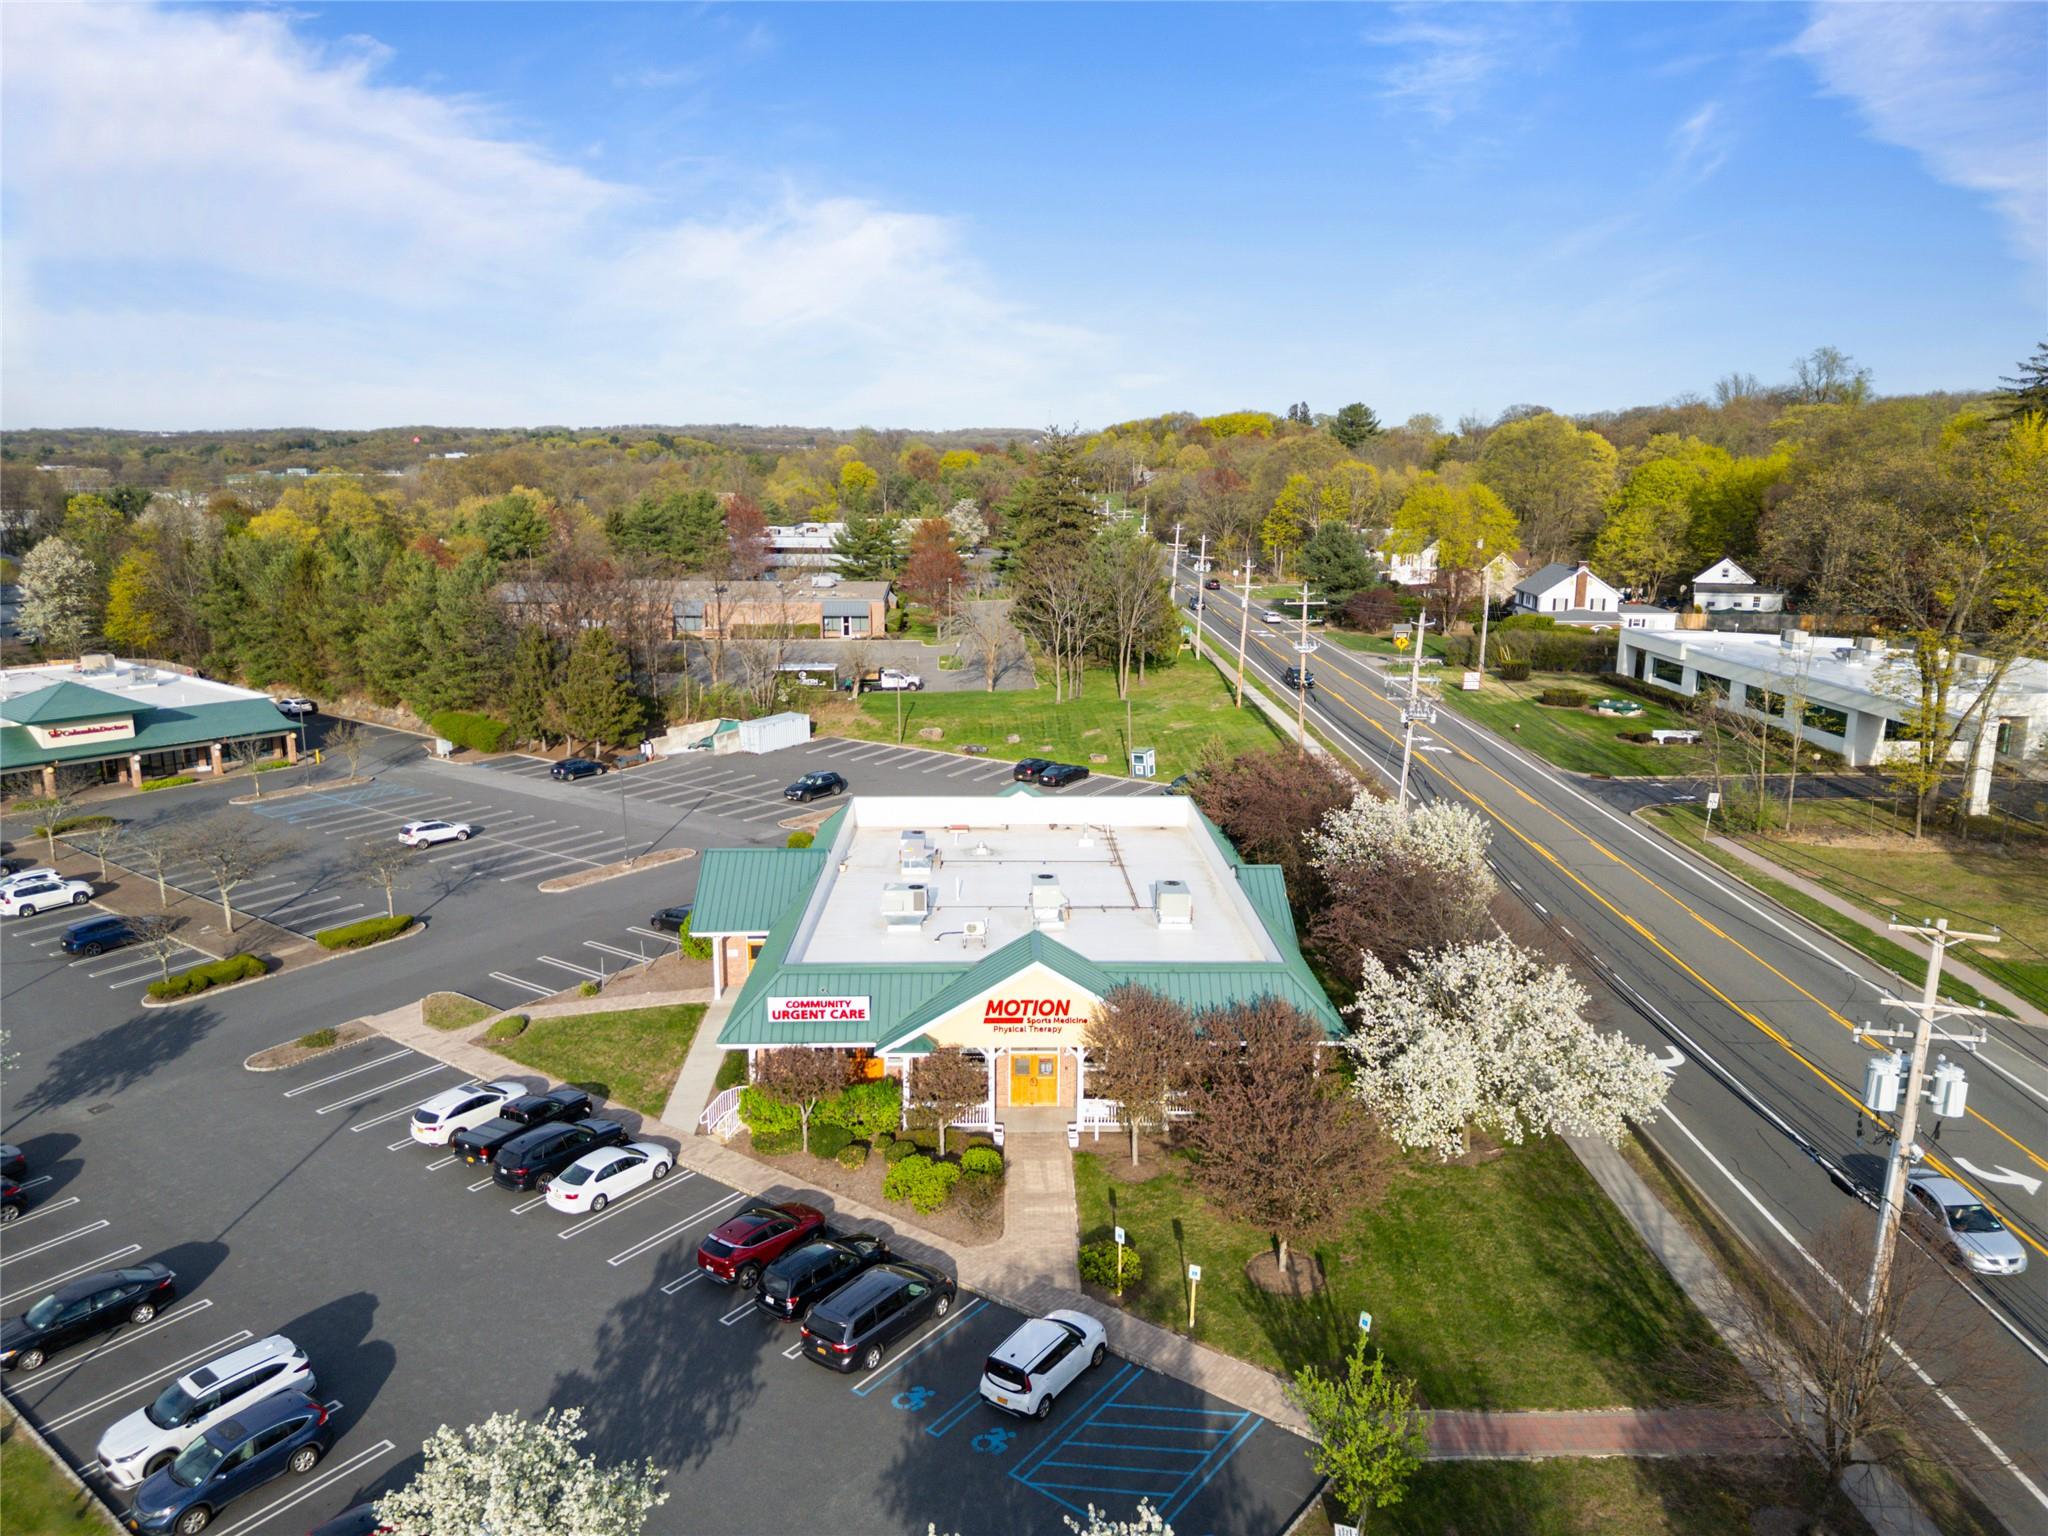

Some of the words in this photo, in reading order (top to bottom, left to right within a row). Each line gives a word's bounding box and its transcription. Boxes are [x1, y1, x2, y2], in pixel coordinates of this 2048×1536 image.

[785, 1000, 852, 1009] COMMUNITY
[985, 999, 1071, 1016] MOTION
[772, 1009, 826, 1020] URGENT
[830, 1009, 865, 1019] CARE
[1026, 1017, 1052, 1025] Sports
[993, 1025, 1027, 1034] Physical
[1029, 1025, 1062, 1034] Therapy
